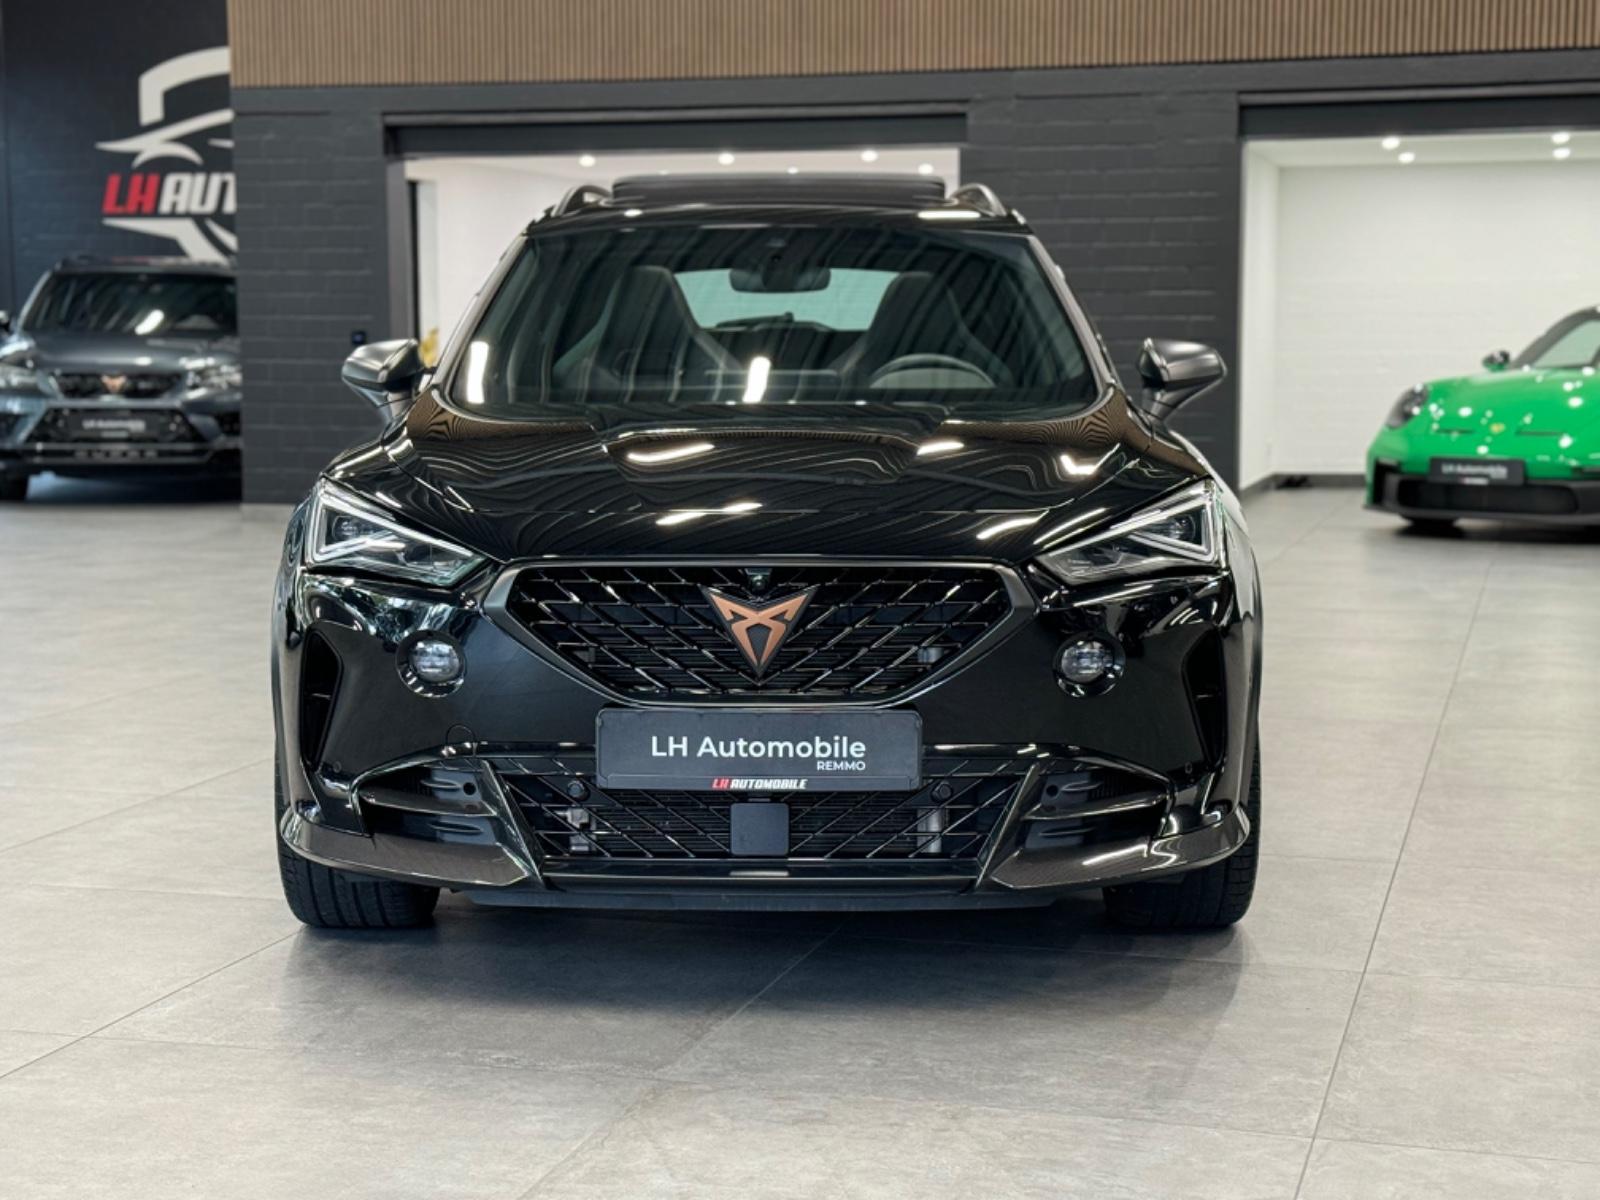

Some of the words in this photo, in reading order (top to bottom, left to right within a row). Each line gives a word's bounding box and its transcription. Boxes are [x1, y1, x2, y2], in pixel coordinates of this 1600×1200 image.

[651, 735, 688, 757] LH
[697, 735, 866, 758] Automobile
[816, 760, 866, 771] REMMO
[730, 778, 808, 790] AUTOMOBILE
